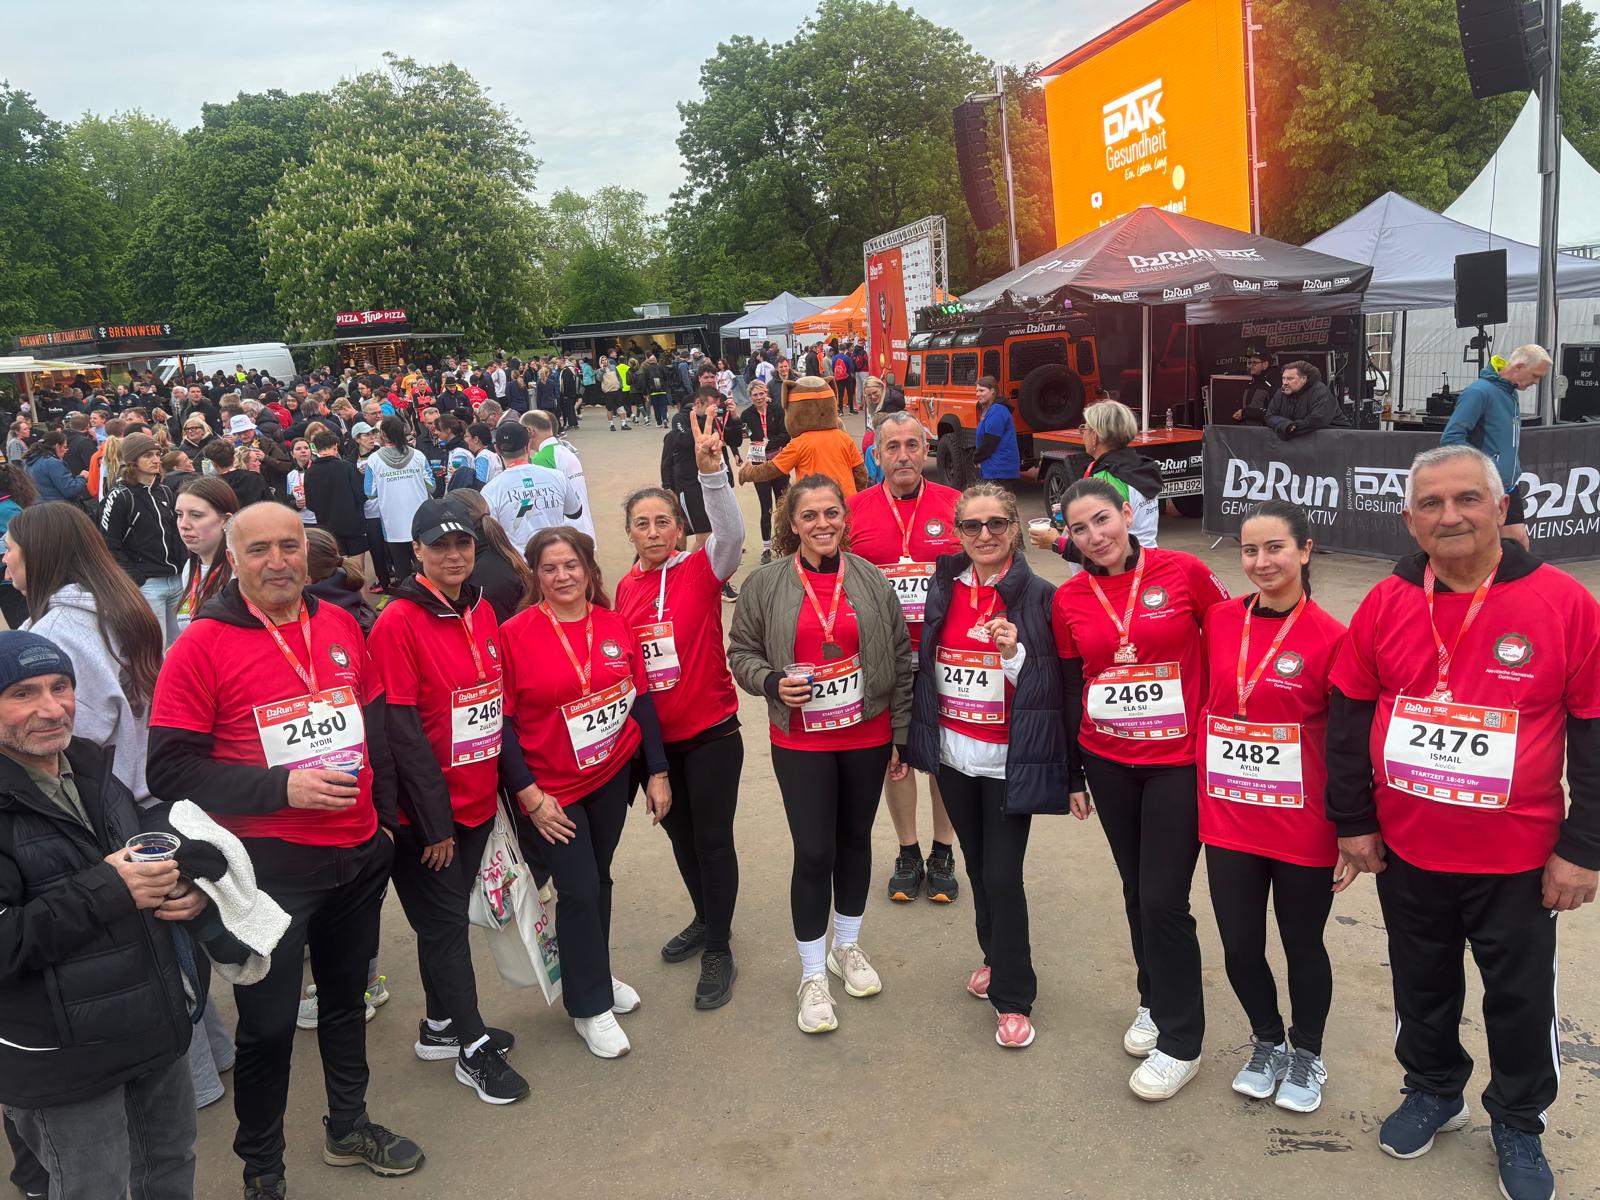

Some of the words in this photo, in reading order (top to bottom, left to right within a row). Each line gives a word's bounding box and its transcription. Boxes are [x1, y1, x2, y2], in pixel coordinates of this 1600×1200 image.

[1103, 78, 1166, 147] DAK
[1105, 127, 1168, 171] Gesundheit
[1127, 248, 1214, 268] B2Run
[1163, 287, 1193, 299] B2Run
[1233, 280, 1260, 290] B2Run
[1302, 279, 1332, 289] B2Run
[336, 315, 359, 323] PIZZA
[1241, 317, 1331, 338] Eventservice
[108, 325, 162, 338] BRENNWERK
[1266, 329, 1330, 347] Germany
[1222, 458, 1339, 508] B2Run
[1346, 466, 1358, 482] by
[1355, 467, 1412, 497] DA
[1185, 480, 1201, 490] 892
[1347, 481, 1359, 510] powered
[1354, 494, 1410, 521] Gesund
[1525, 516, 1600, 540] MEINSAM
[813, 672, 859, 698] 2477
[943, 665, 988, 688] 2474
[1104, 683, 1163, 705] 2469
[266, 705, 293, 722] B2Run
[467, 698, 502, 726] 2468
[582, 698, 629, 732] 2475
[1405, 701, 1432, 714] B2Run
[309, 736, 333, 749] AYDIN
[1409, 723, 1490, 757] 2476
[1222, 740, 1281, 765] 2482
[1430, 752, 1462, 764] ISMAIL
[1239, 763, 1261, 772] AYLIN
[1410, 769, 1445, 780] STARTZEIT
[1446, 775, 1465, 784] 18:45
[1467, 778, 1480, 786] Uhr
[1226, 777, 1252, 787] STARTZEIT
[1252, 781, 1267, 789] 18:45
